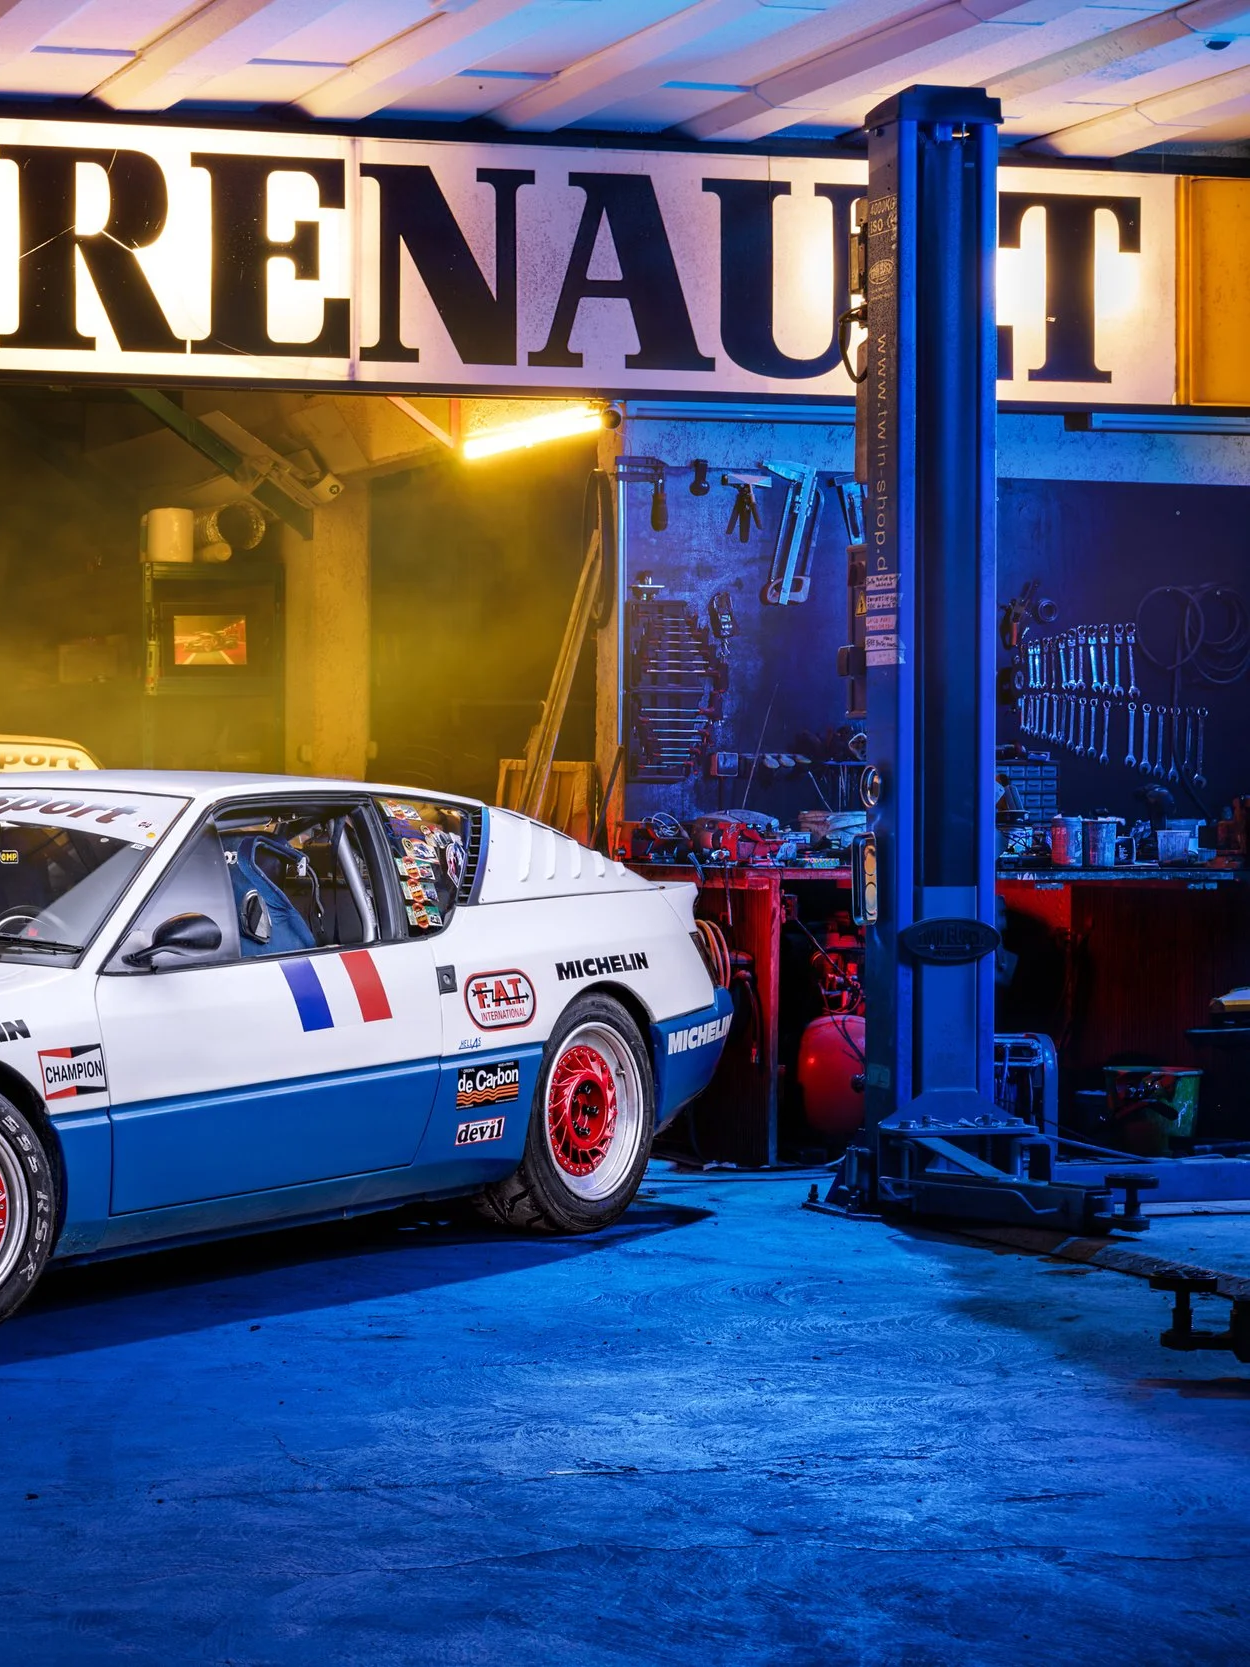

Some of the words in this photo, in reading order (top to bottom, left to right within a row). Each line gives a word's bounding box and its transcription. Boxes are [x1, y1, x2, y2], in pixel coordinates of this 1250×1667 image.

[0, 145, 1141, 384] RENAUT
[1, 852, 18, 862] OMP
[555, 952, 649, 981] MICHELIN
[481, 1007, 527, 1022] INTERNATIONAL
[668, 1013, 733, 1056] MICHELIN
[45, 1059, 104, 1084] CHAMPION
[458, 1074, 474, 1093] de
[475, 1067, 519, 1091] Carbon
[457, 1118, 503, 1143] devil
[2, 1114, 40, 1174] 595
